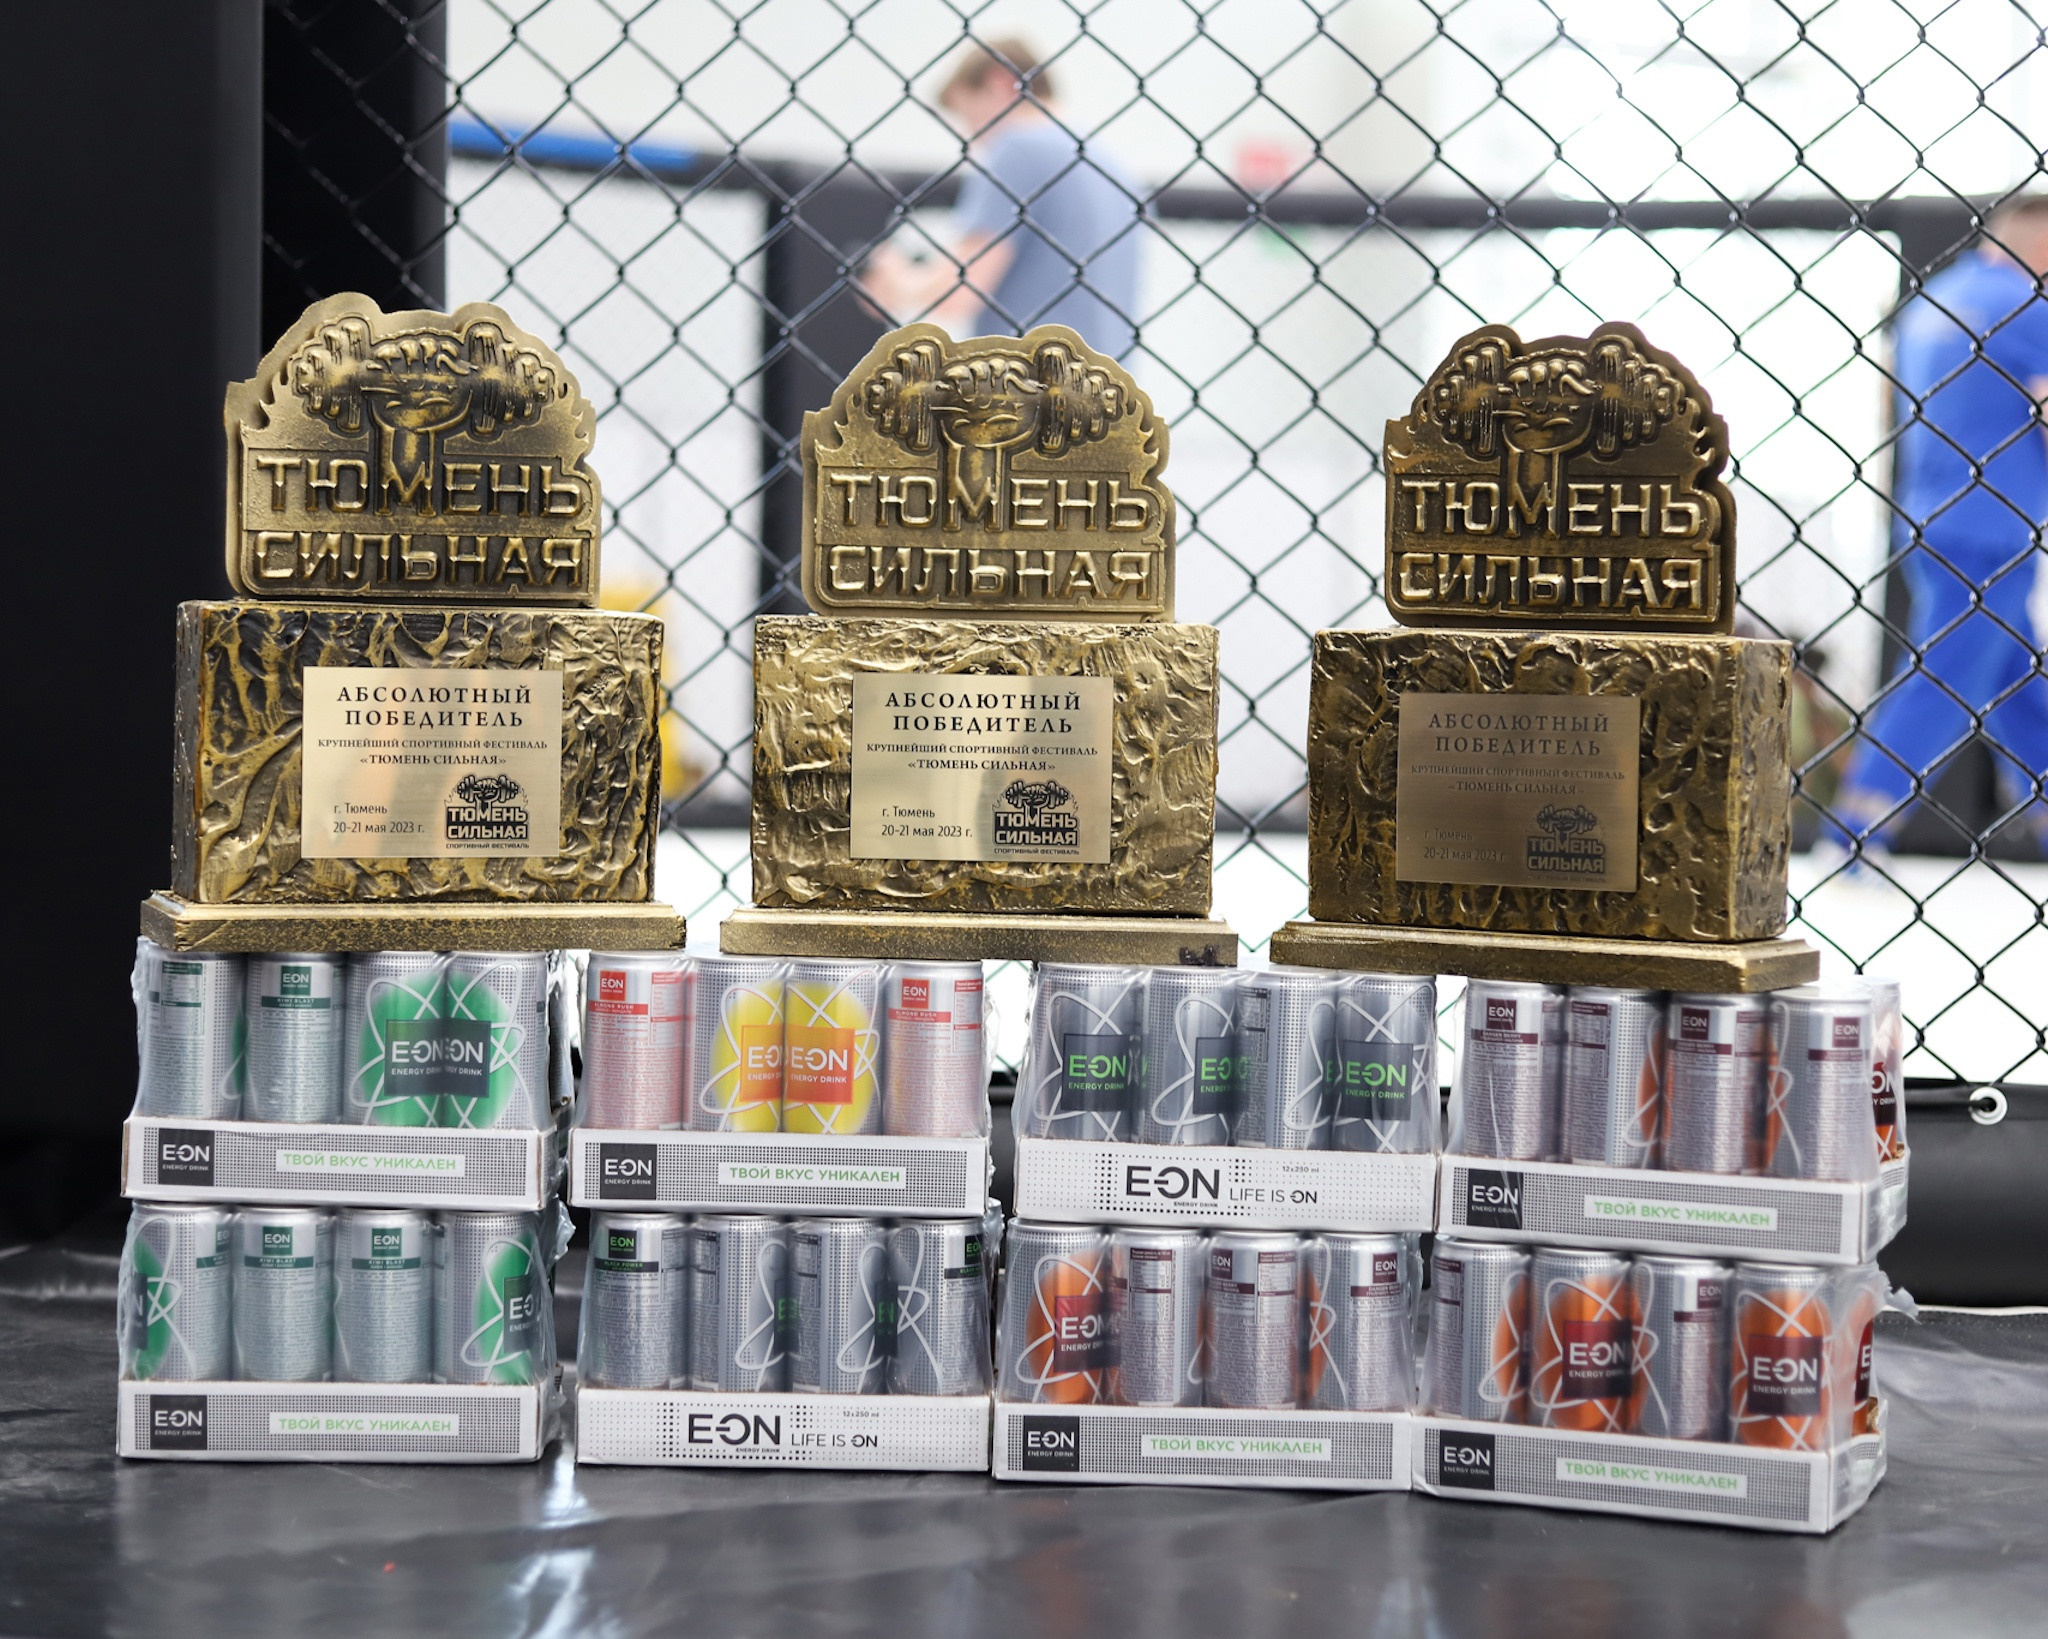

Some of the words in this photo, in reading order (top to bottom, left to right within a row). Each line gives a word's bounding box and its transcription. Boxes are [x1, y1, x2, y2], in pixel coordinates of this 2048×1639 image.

[256, 455, 583, 518] ТЮМЕНЬ
[830, 472, 1150, 533] ТЮМЕНЬ
[1401, 480, 1701, 540] ТЮМЕНЬ
[254, 531, 583, 586] СИЛЬНАЯ
[829, 545, 1152, 600] СИЛЬНАЯ
[1398, 553, 1703, 610] СИЛЬНАЯ
[336, 684, 532, 704] АБСОЛЮТНЫЙ
[885, 691, 1080, 710] АБСОЛЮТНЫЙ
[345, 710, 523, 730] ПОБЕДИТЕЛЬ
[893, 716, 1072, 734] ПОБЕДИТЕЛЬ
[1428, 712, 1609, 732] АБСОЛЮТНЫЙ
[318, 738, 399, 749] КРУПНЕЙШИЙ
[402, 739, 481, 749] СПОРТИВНЫЙ
[483, 740, 548, 750] ФЕСТИВАЛЬ
[866, 743, 947, 753] КРУПНЕЙШИЙ
[949, 744, 1029, 754] СПОРТИВНЫЙ
[1031, 746, 1098, 755] ФЕСТИВАЛЬ
[1436, 736, 1601, 757] ПОБЕДИТЕЛЬ
[360, 754, 430, 765] «ТЮМЕНЬ
[434, 755, 506, 766] СИЛЬНАЯ»
[908, 760, 978, 769] «ТЮМЕНЬ
[981, 760, 1055, 771] СИЛЬНАЯ»
[1411, 765, 1484, 775] КРУПНЕЙШИЙ
[1486, 767, 1559, 778] СПОРТИВНЫЙ
[1562, 769, 1625, 780] ФЕСТИВАЛЬ
[1448, 782, 1512, 792] «ТЮМЕНЬ
[1515, 784, 1584, 795] СИЛЬНАЯ»
[334, 805, 340, 814] г.
[345, 803, 388, 814] Тюмень
[447, 807, 528, 822] ТЮМЕНЬ
[882, 808, 889, 817] г.
[893, 806, 935, 818] Тюмень
[333, 822, 362, 833] 20-21
[365, 824, 386, 833] мая
[389, 822, 415, 833] 2023
[418, 825, 425, 833] г.
[996, 813, 1077, 828] ТЮМЕНЬ
[447, 825, 527, 839] СИЛЬНАЯ
[881, 825, 909, 836] 20-21
[913, 827, 934, 836] мая
[937, 826, 962, 837] 2023
[966, 828, 973, 837] г.
[995, 830, 1076, 845] СИЛЬНАЯ
[1424, 832, 1431, 840] г.
[1434, 829, 1473, 841] Тюмень
[1423, 847, 1449, 860] 20-21
[1452, 850, 1472, 861] мая
[1474, 849, 1498, 862] 2023
[1500, 852, 1507, 862] г.
[1528, 838, 1605, 856] ТЮМЕНЬ
[1527, 856, 1604, 872] СИЛЬНАЯ
[283, 973, 309, 983] EON
[601, 978, 624, 988] EON
[902, 986, 926, 997] EON
[1488, 1006, 1514, 1018] EON
[1682, 1016, 1707, 1028] EON
[1834, 1024, 1859, 1035] EON
[791, 1046, 848, 1071] EON
[1068, 1054, 1127, 1078] EON
[459, 1068, 482, 1076] DRINK
[747, 1072, 774, 1081] ENERGY
[791, 1073, 818, 1082] ENERGY
[820, 1075, 847, 1084] DRINK
[1346, 1062, 1407, 1087] EON
[1068, 1082, 1102, 1090] ENERGY
[1200, 1084, 1227, 1094] ENERGY
[1346, 1089, 1376, 1098] ENERGY
[1378, 1090, 1406, 1099] DRINK
[162, 1144, 209, 1162] EON
[284, 1152, 325, 1166] ТВОЙ
[330, 1155, 368, 1168] ВКУС
[374, 1156, 456, 1170] УНИКАЛЕН
[604, 1158, 652, 1176] EON
[730, 1165, 770, 1179] ТВОЙ
[775, 1168, 814, 1181] ВКУС
[818, 1169, 900, 1183] УНИКАЛЕН
[1126, 1165, 1220, 1200] EON
[1230, 1188, 1266, 1202] LIFE
[1271, 1189, 1285, 1203] IS
[1290, 1190, 1318, 1204] ON
[1472, 1186, 1518, 1206] EON
[1472, 1205, 1496, 1213] ENERGY
[1498, 1206, 1517, 1214] DRINK
[1594, 1200, 1636, 1216] ТВОЙ
[1642, 1203, 1680, 1219] ВКУС
[1685, 1209, 1770, 1226] УНИКАЛЕН
[264, 1234, 290, 1244] EON
[374, 1235, 400, 1246] EON
[610, 1236, 634, 1248] EON
[1212, 1255, 1231, 1267] EON
[1375, 1260, 1397, 1272] EON
[1699, 1286, 1722, 1297] EON
[1061, 1342, 1092, 1352] ENERGY
[1569, 1340, 1626, 1366] EON
[1569, 1369, 1604, 1379] ENERGY
[1754, 1357, 1818, 1383] EON
[1753, 1384, 1788, 1394] ENERGY
[1790, 1386, 1817, 1395] DRINK
[155, 1410, 202, 1427] EON
[279, 1416, 320, 1430] ТВОЙ
[326, 1419, 364, 1431] ВКУС
[370, 1420, 451, 1432] УНИКАЛЕН
[688, 1413, 780, 1445] EON
[791, 1433, 827, 1447] LIFE
[832, 1434, 846, 1448] IS
[850, 1434, 878, 1448] ON
[1028, 1430, 1074, 1449] EON
[1150, 1436, 1192, 1450] ТВОЙ
[1196, 1440, 1234, 1452] ВКУС
[1240, 1440, 1322, 1454] УНИКАЛЕН
[1028, 1450, 1052, 1458] ENERGY
[1444, 1446, 1490, 1466] EON
[1444, 1466, 1468, 1474] ENERGY
[1470, 1468, 1490, 1476] DRINK
[1566, 1462, 1606, 1478] ТВОЙ
[1611, 1464, 1650, 1481] ВКУС
[1655, 1470, 1738, 1490] УНИКАЛЕН
